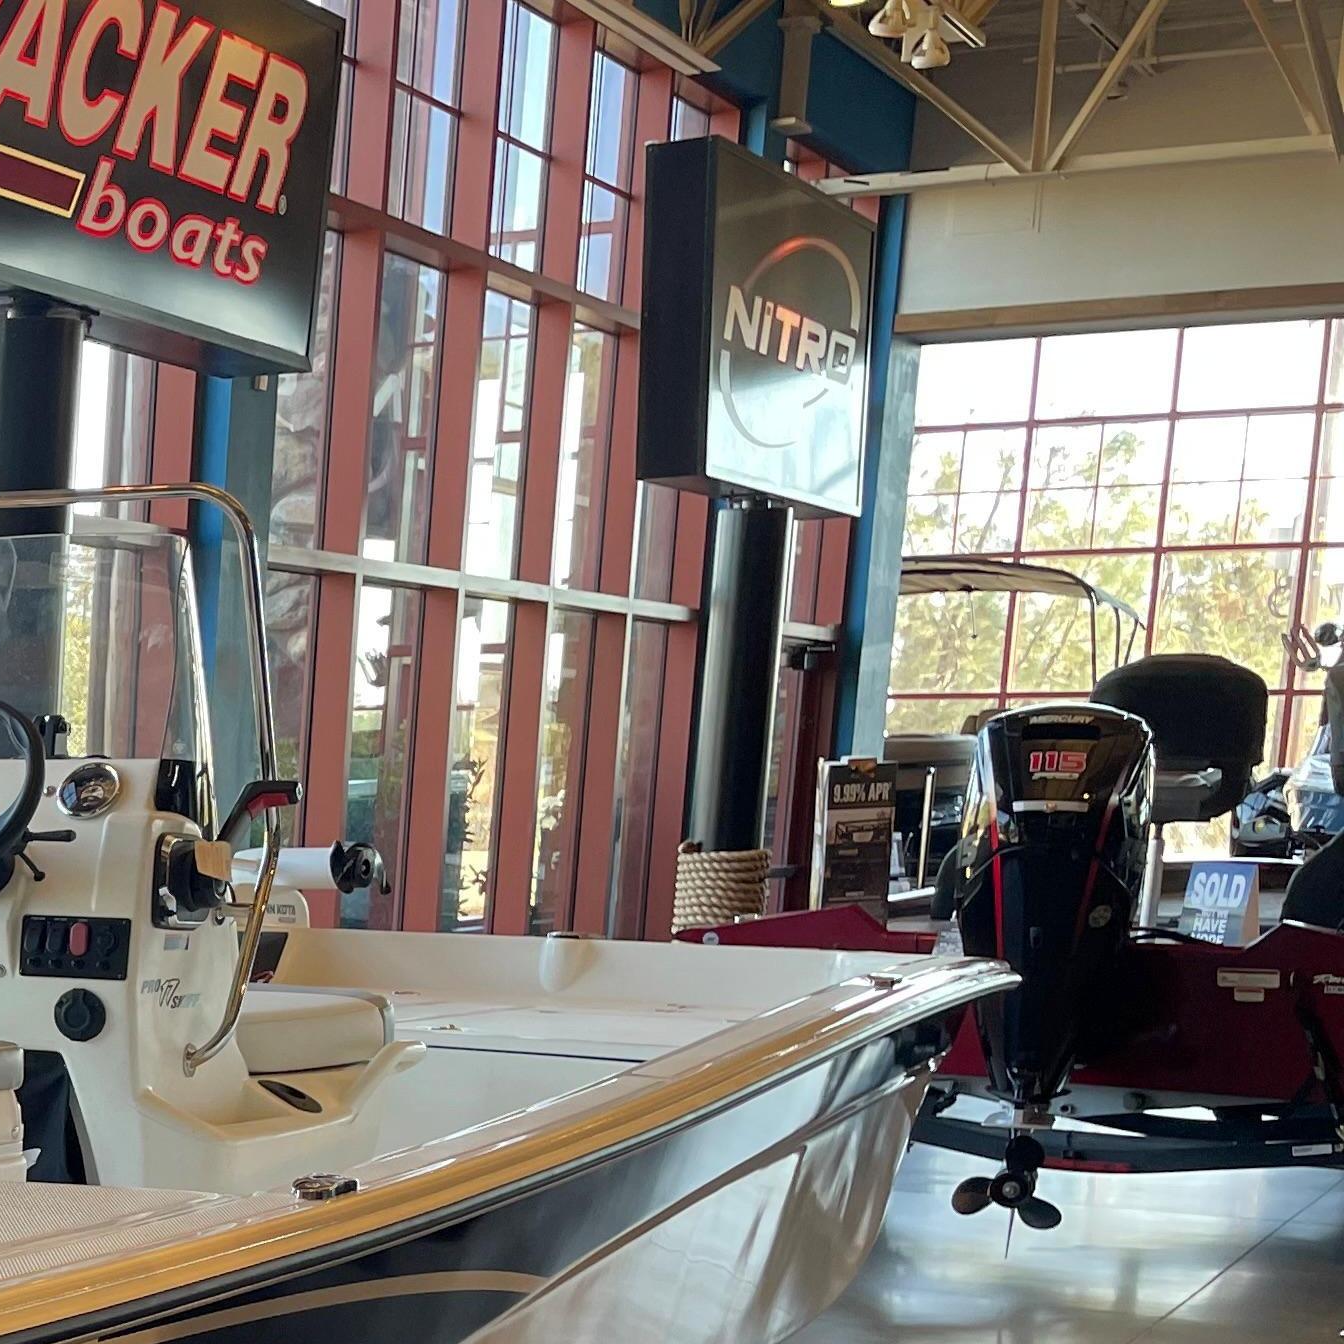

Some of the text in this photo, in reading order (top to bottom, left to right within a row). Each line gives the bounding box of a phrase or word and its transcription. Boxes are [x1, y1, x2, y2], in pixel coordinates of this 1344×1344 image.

[75, 157, 269, 286] boats
[723, 285, 857, 385] NITRO
[1029, 715, 1095, 724] MERCURY
[1029, 751, 1087, 772] 115
[833, 783, 866, 804] 9.99%
[1191, 872, 1246, 908] SOLD
[277, 904, 296, 916] KOTA
[1193, 918, 1227, 934] HAVE
[141, 979, 161, 994] PRO
